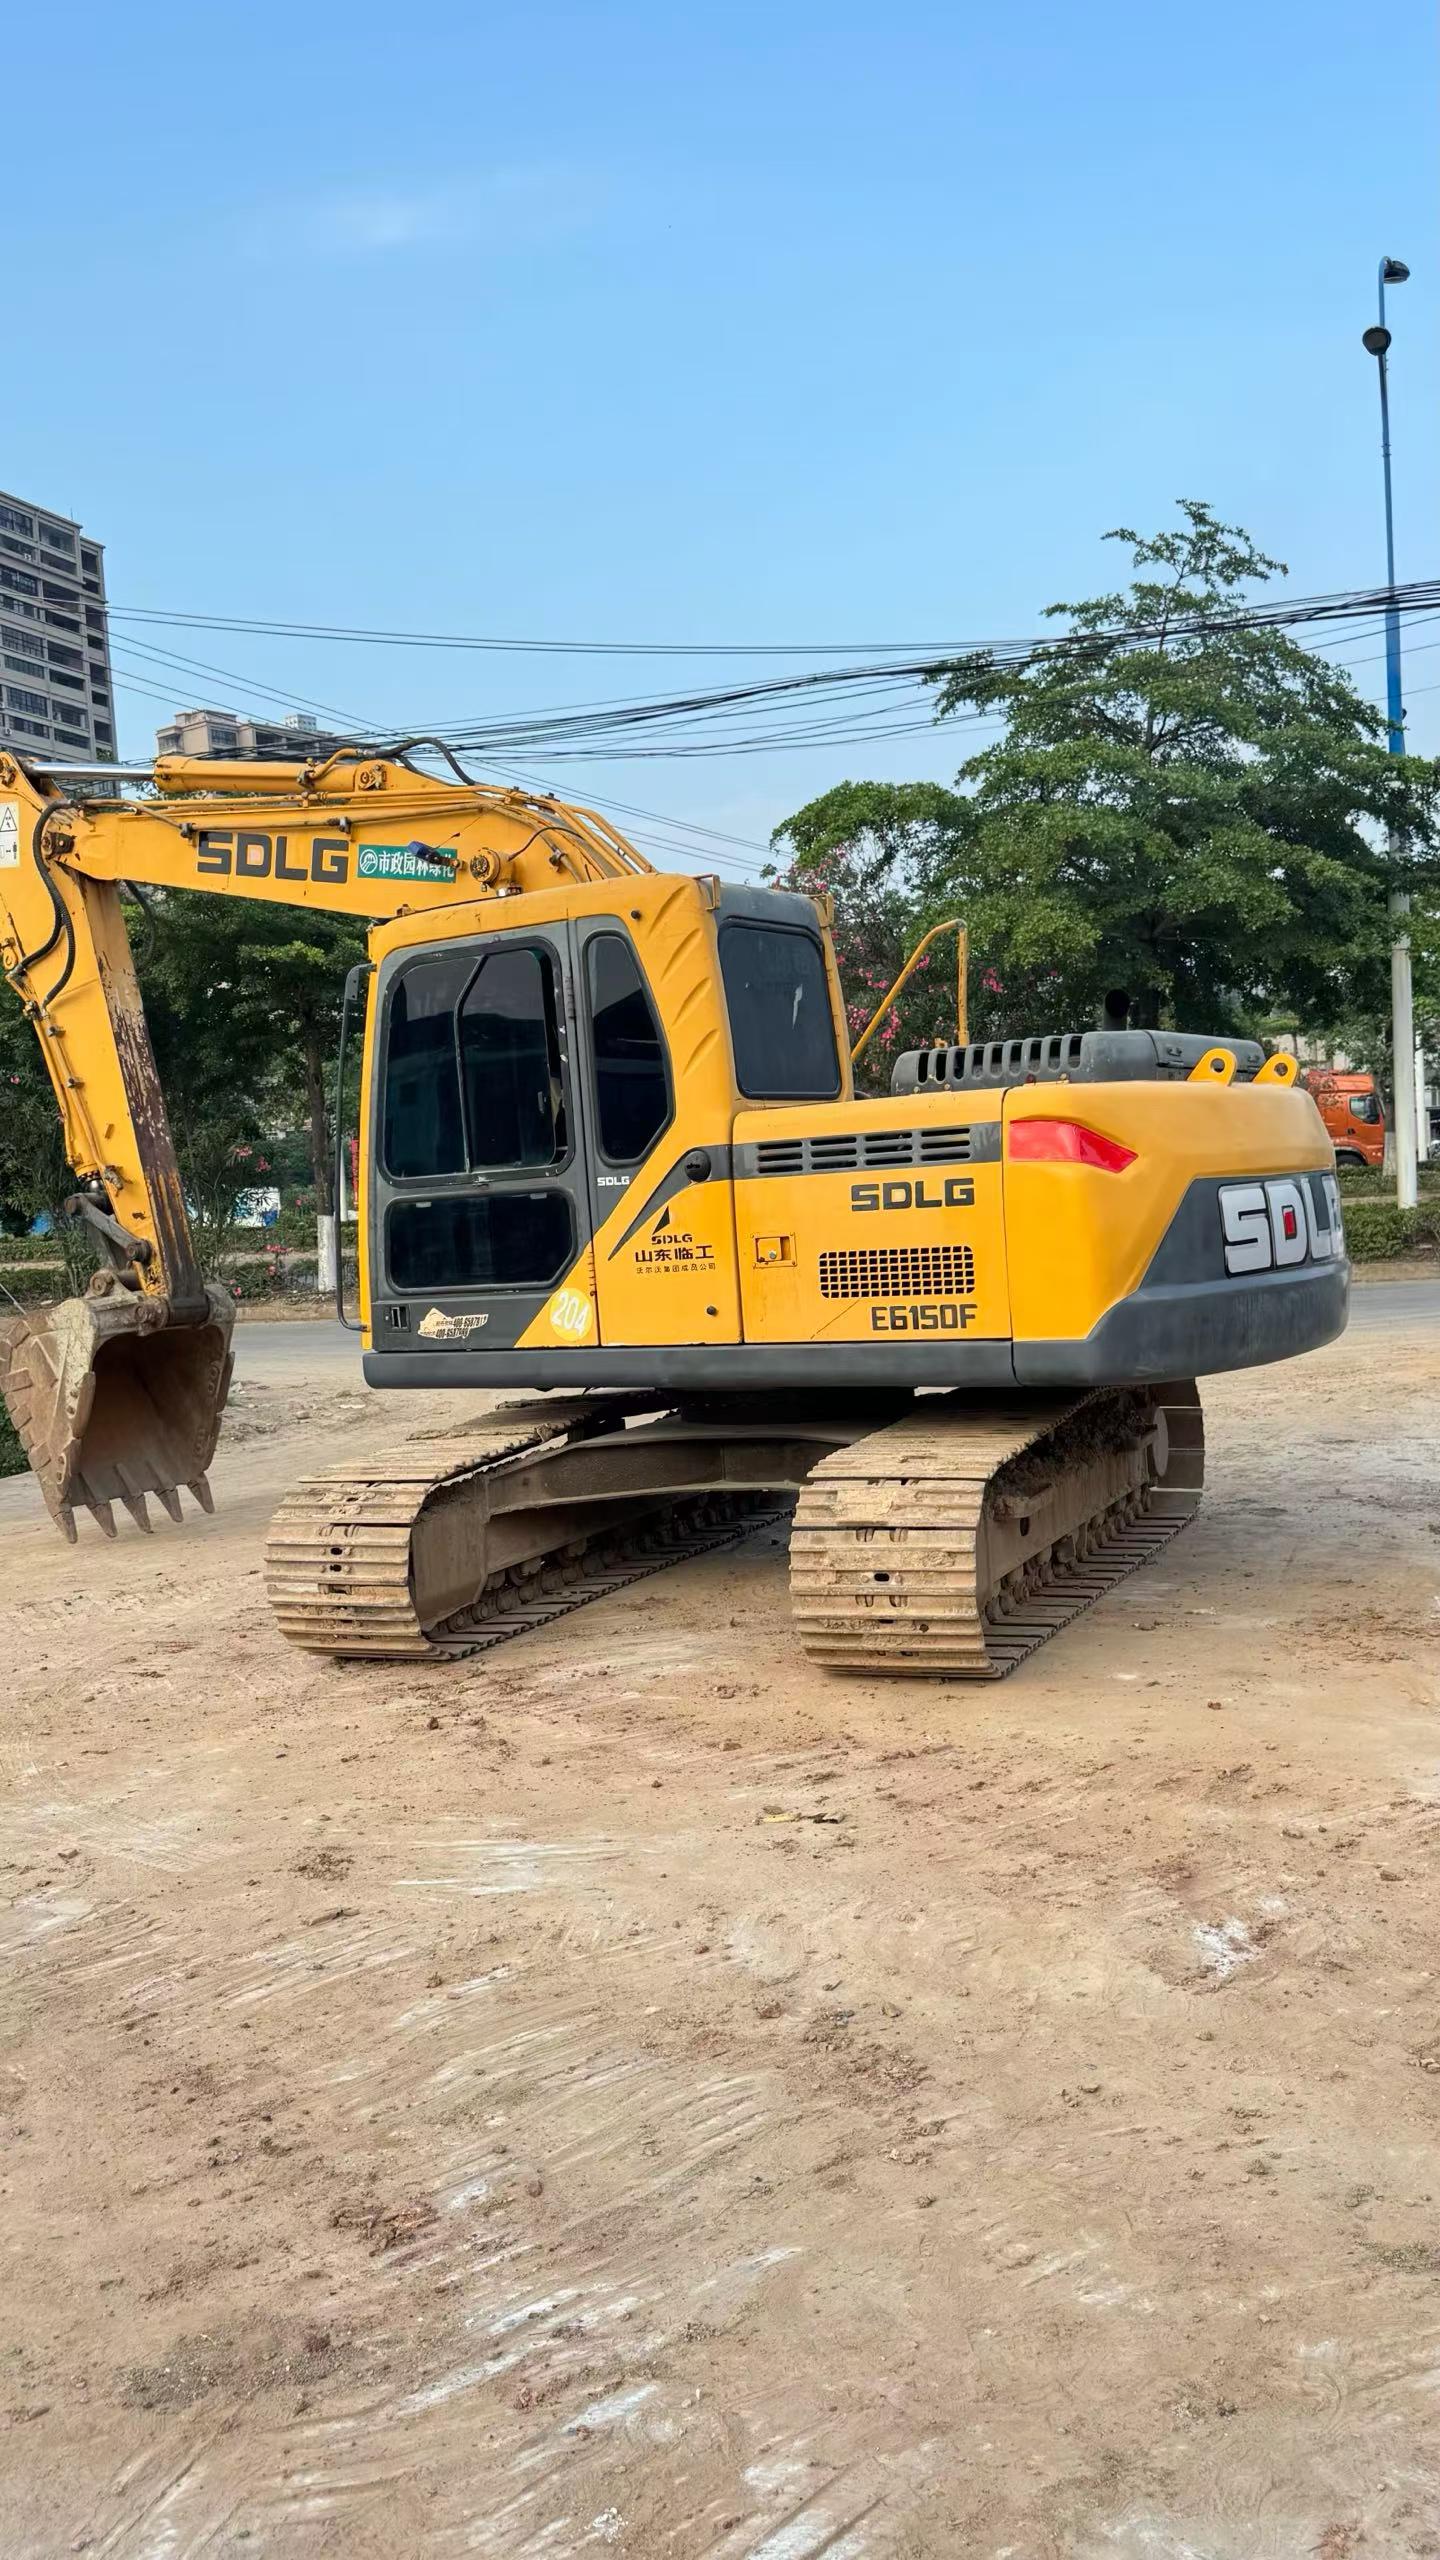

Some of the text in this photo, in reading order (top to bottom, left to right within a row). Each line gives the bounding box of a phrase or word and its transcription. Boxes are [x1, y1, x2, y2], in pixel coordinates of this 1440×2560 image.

[197, 831, 349, 884] SDLG
[597, 1176, 630, 1187] SDLG
[851, 1177, 975, 1212] SDLG
[651, 1233, 693, 1245] SDLG
[635, 1245, 714, 1262] 山东临工
[551, 1290, 589, 1337] 204
[871, 1303, 978, 1331] E6150F
